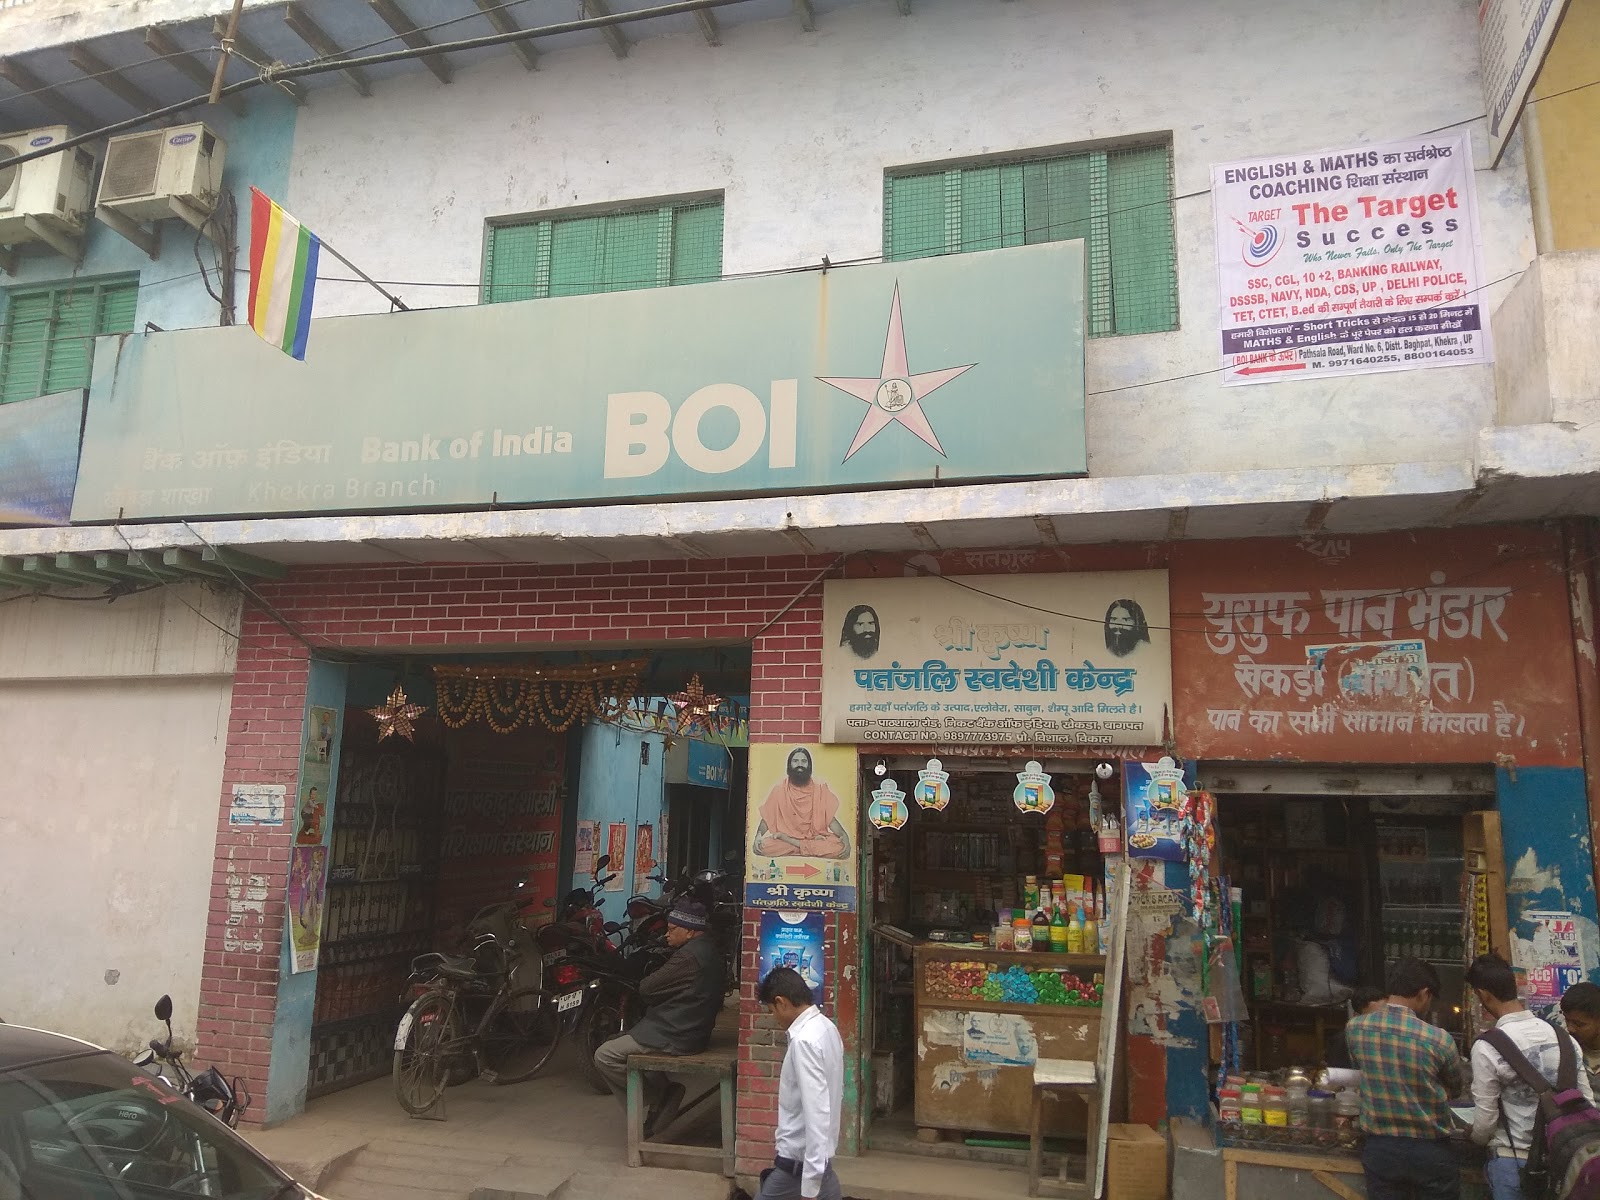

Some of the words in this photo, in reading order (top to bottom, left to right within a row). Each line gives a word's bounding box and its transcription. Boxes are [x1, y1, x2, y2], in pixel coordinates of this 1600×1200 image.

[1225, 162, 1296, 184] ENGLISH
[1302, 160, 1314, 174] &
[1320, 151, 1378, 172] MATHS
[1383, 152, 1400, 164] का
[1250, 176, 1342, 200] COACHING
[1346, 173, 1379, 188] शिक्षा
[1382, 168, 1429, 184] संस्थान
[1248, 208, 1282, 222] TARGET
[1292, 202, 1348, 226] The
[1358, 187, 1458, 218] Target
[1297, 218, 1458, 248] Success
[1303, 253, 1322, 262] Who
[1384, 244, 1404, 254] Only
[1406, 241, 1422, 252] The
[1426, 240, 1454, 250] Target
[1248, 278, 1272, 289] SSC,
[1275, 274, 1300, 286] CGL,
[1303, 272, 1316, 282] 10
[1338, 264, 1388, 279] BANKING
[1391, 259, 1442, 274] RAILWAY,
[1230, 294, 1268, 307] DSSSB,
[1272, 290, 1302, 302] NAVY,
[1305, 287, 1331, 298] NDA,
[1334, 284, 1359, 296] CDS,
[1387, 277, 1420, 290] DELHI
[1424, 272, 1467, 287] POLICE,
[1233, 310, 1256, 322] TET,
[1258, 306, 1288, 319] CTET,
[1292, 304, 1314, 316] B.ed
[1318, 302, 1329, 312] की
[1304, 320, 1333, 331] Short
[1336, 316, 1370, 328] Tricks
[1429, 312, 1438, 320] 20
[1244, 336, 1282, 348] MATHS
[1286, 336, 1294, 344] &
[1297, 332, 1336, 343] English
[1298, 348, 1326, 360] Pathsala
[1328, 346, 1346, 357] Road,
[1346, 344, 1363, 355] Ward
[1366, 343, 1376, 352] No.
[1404, 338, 1434, 352] Baghpat,
[1434, 336, 1458, 346] Khekra
[1464, 334, 1472, 344] UP
[1328, 355, 1400, 367] 9971640255,
[1404, 348, 1474, 360] 8800164053
[603, 378, 798, 479] BOI
[361, 426, 439, 465] Bank
[450, 426, 483, 460] of
[492, 425, 572, 458] India
[248, 477, 335, 502] Khekra
[346, 472, 436, 498] Branch
[1202, 592, 1312, 655] युसुफ
[1320, 588, 1401, 640] पान
[1402, 570, 1513, 642] भंडार
[854, 660, 959, 692] पतंजलि
[964, 660, 1058, 692] स्वदेशी
[1065, 660, 1137, 696] केन्द्र
[849, 702, 872, 712] हमारे
[894, 702, 928, 712] पतंजलि
[930, 702, 940, 712] के
[1072, 702, 1094, 713] आदि
[1097, 702, 1126, 714] मिलते
[944, 717, 974, 728] निकट
[1206, 709, 1244, 732] पान
[1248, 709, 1283, 734] का
[1286, 702, 1338, 736] सभी
[1342, 711, 1416, 734] सामान
[1422, 700, 1490, 735] मिलता
[864, 730, 918, 740] CONTACT
[944, 731, 1012, 742] 9897773975
[1076, 732, 1113, 744] विकास
[766, 884, 790, 896] श्री
[793, 888, 836, 900] कृष्ण
